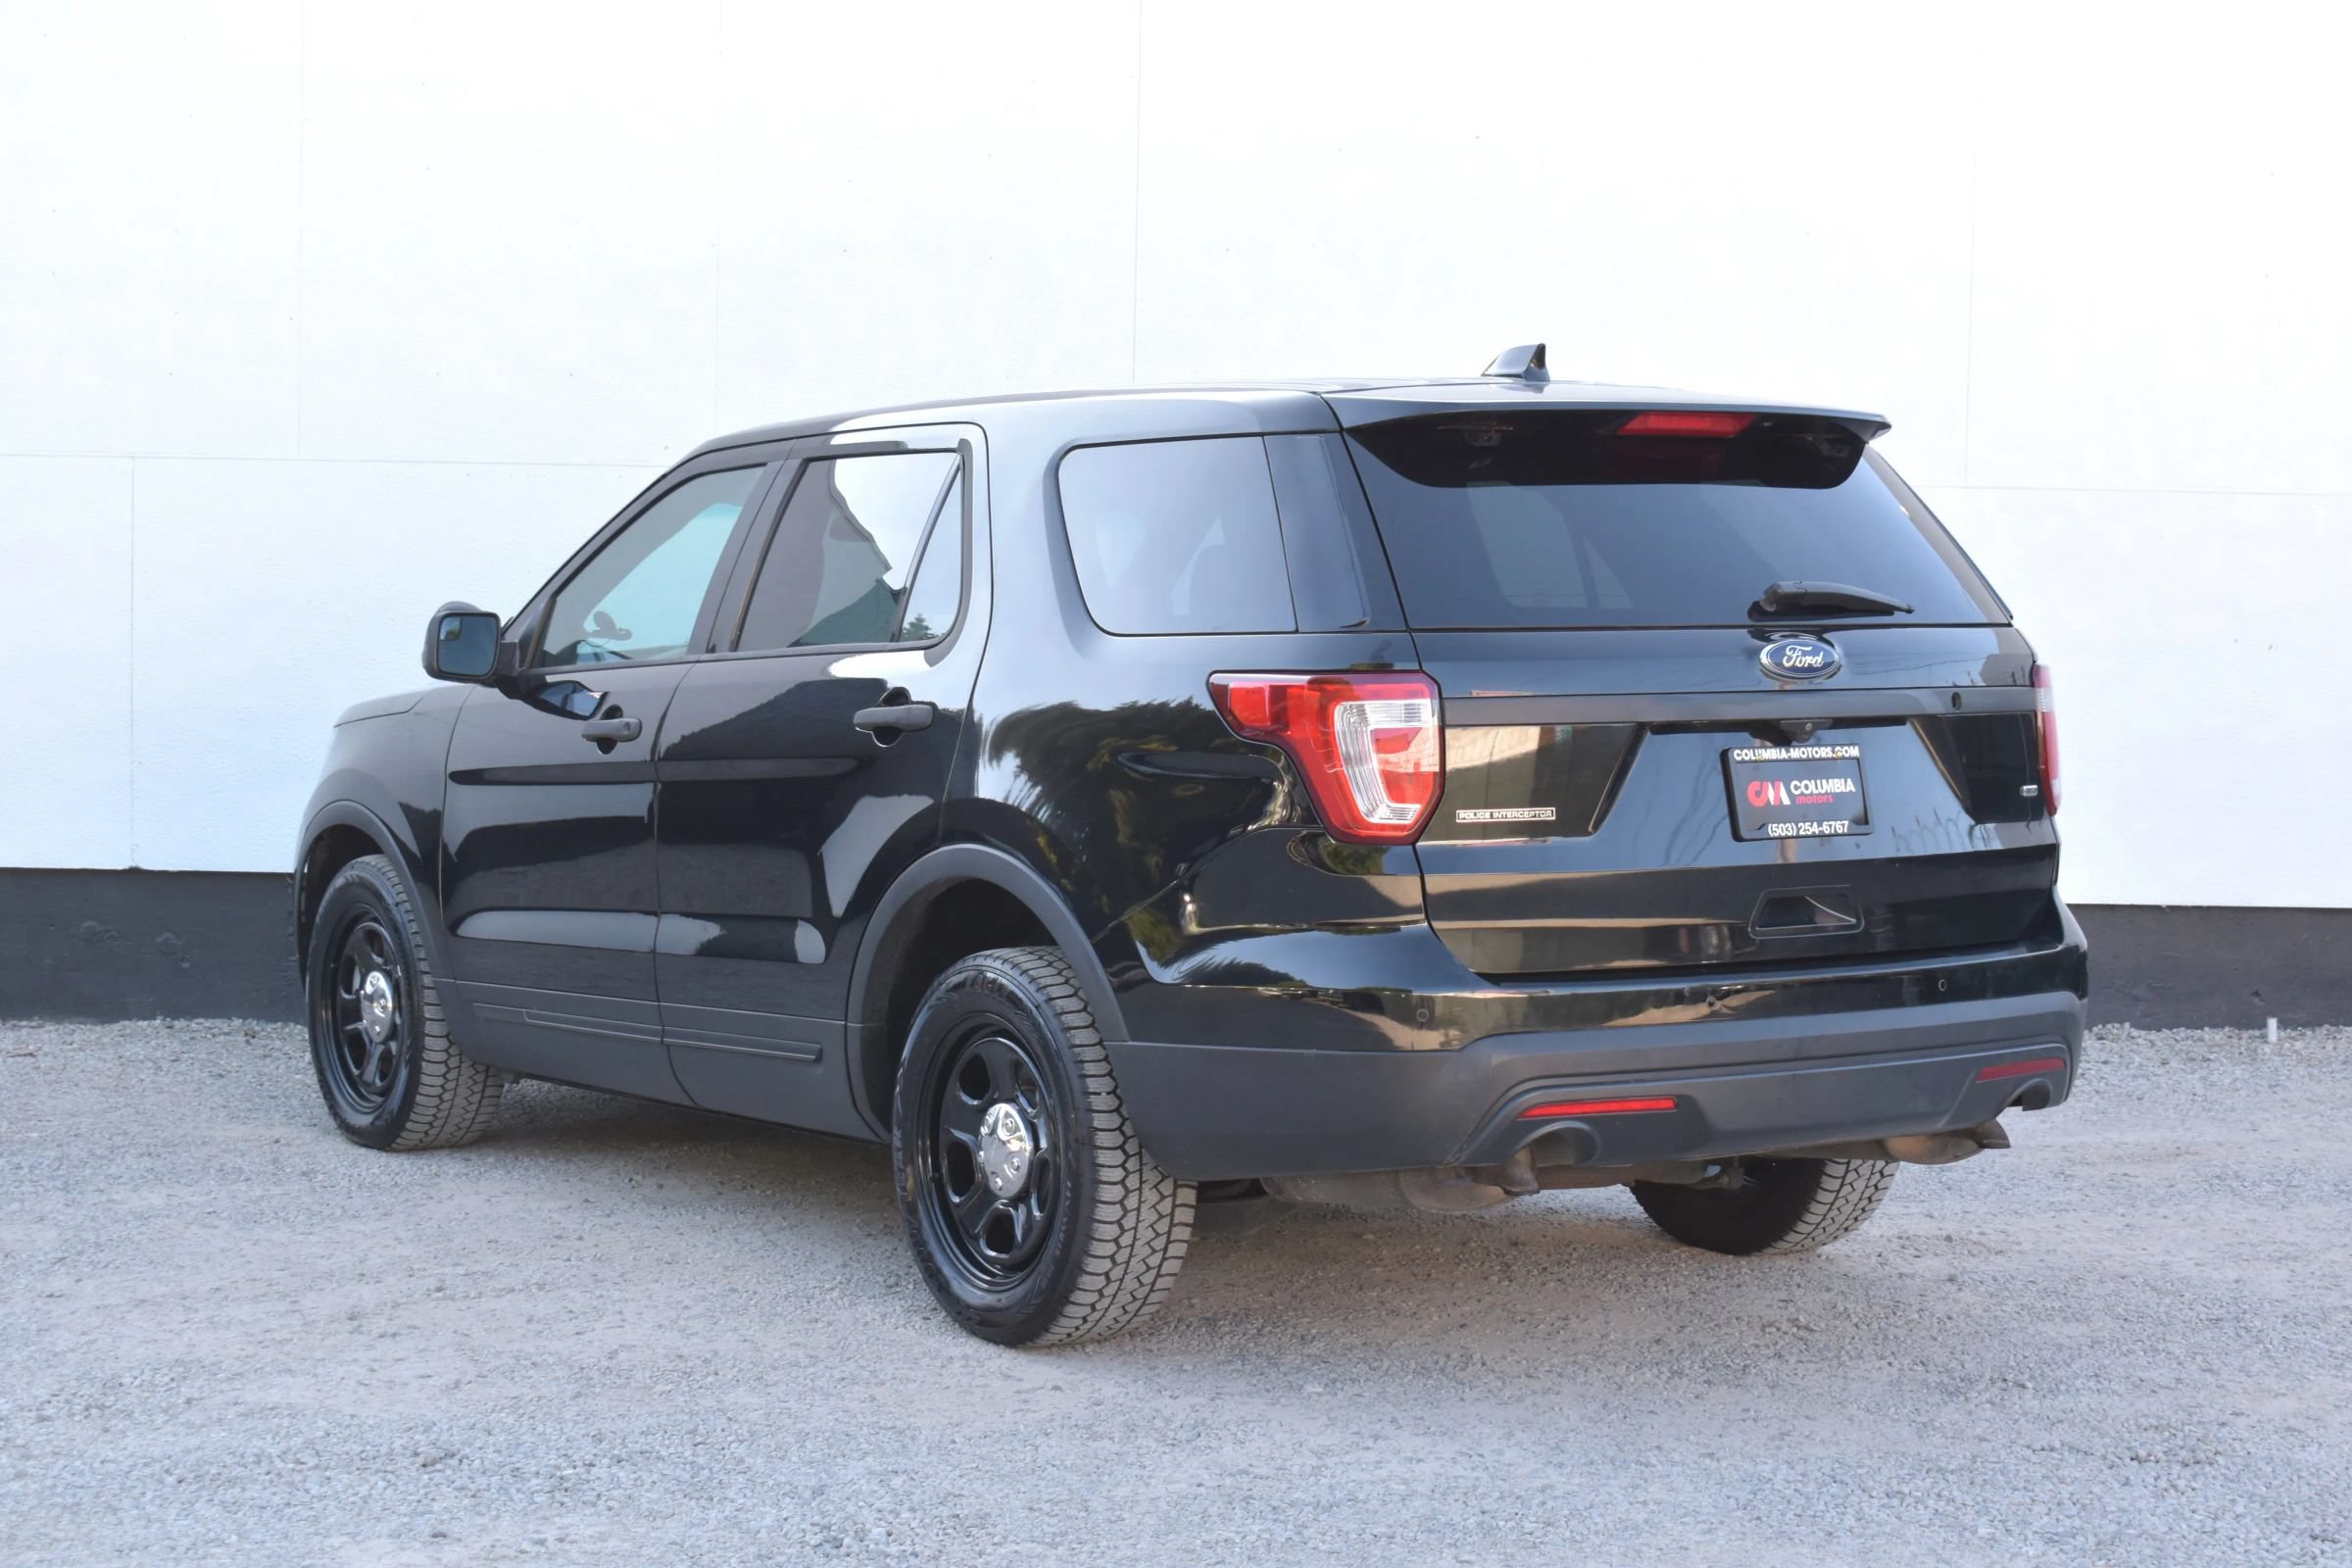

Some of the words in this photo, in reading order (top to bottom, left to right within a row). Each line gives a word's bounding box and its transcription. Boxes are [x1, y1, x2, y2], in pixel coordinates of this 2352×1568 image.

[1783, 645, 1824, 667] Ford
[1734, 747, 1860, 760] COLUMBIA-MOTORS.COM
[1790, 778, 1855, 795] COLUMBIA
[1795, 794, 1835, 805] motors
[1493, 810, 1552, 819] INTERCEPTOR
[1768, 822, 1797, 837] (503)
[1797, 820, 1849, 836] 254-6767
